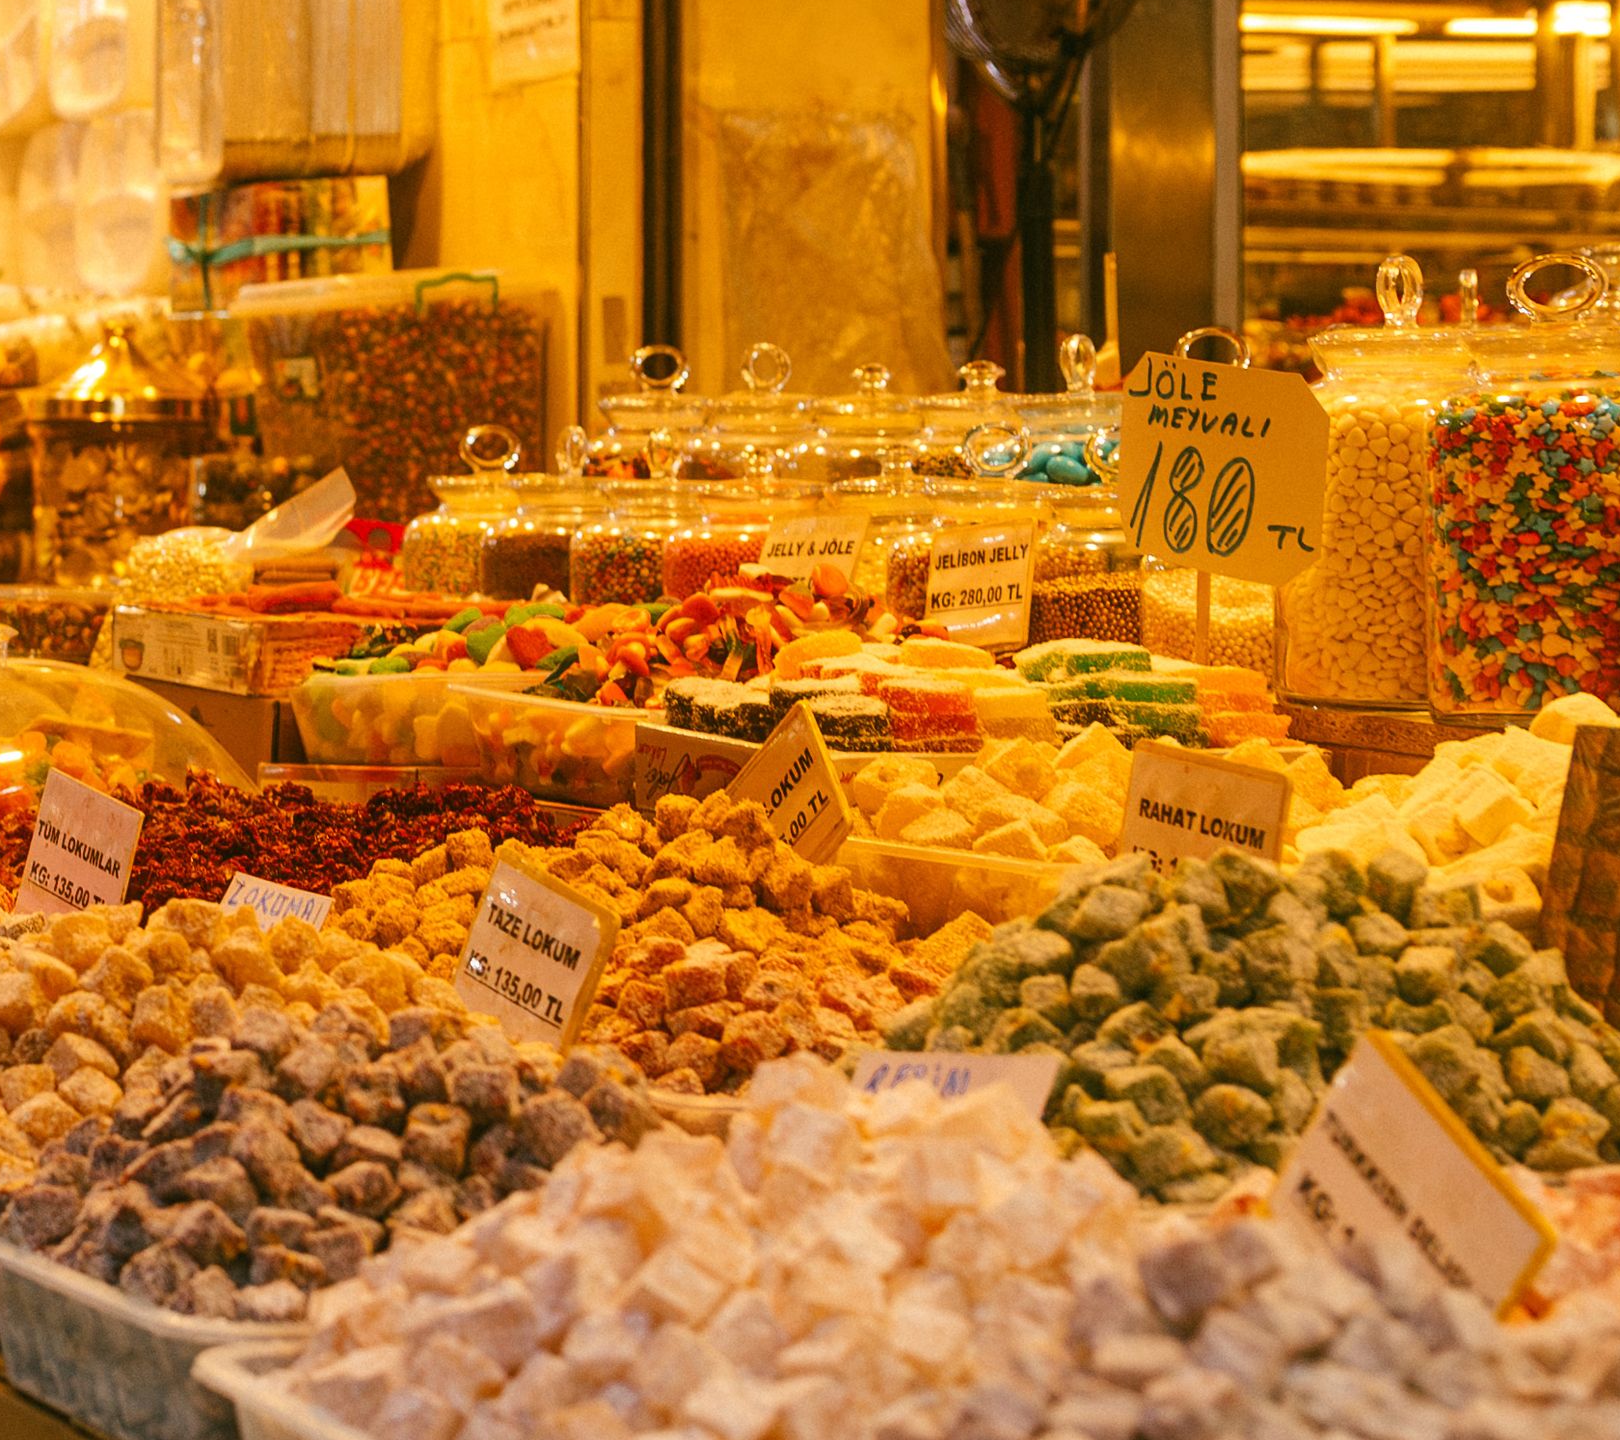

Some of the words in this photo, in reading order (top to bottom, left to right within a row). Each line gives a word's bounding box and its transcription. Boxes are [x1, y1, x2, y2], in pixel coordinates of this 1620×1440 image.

[1128, 357, 1218, 401] JÖLE
[1148, 404, 1271, 438] MEYVALI
[1130, 441, 1255, 558] 180
[1268, 525, 1314, 553] TL
[767, 540, 802, 558] JELLY
[819, 538, 855, 557] JÖLE
[934, 548, 986, 571] JELİBON
[989, 543, 1029, 564] JELLY
[930, 591, 956, 609] KG:
[960, 586, 1003, 608] 280,00
[1007, 583, 1023, 601] TL
[808, 790, 829, 815] TL
[1139, 798, 1197, 831] RAHAT
[1200, 814, 1266, 850] LOKUM
[38, 820, 61, 846] TÜM
[61, 832, 121, 880] LOKUMLAR
[30, 860, 50, 887] KG:
[53, 874, 90, 908] 135,00
[487, 903, 523, 939] TAZE
[522, 923, 581, 972] LOKUM
[494, 966, 542, 1009] 135,00
[545, 994, 564, 1024] TL
